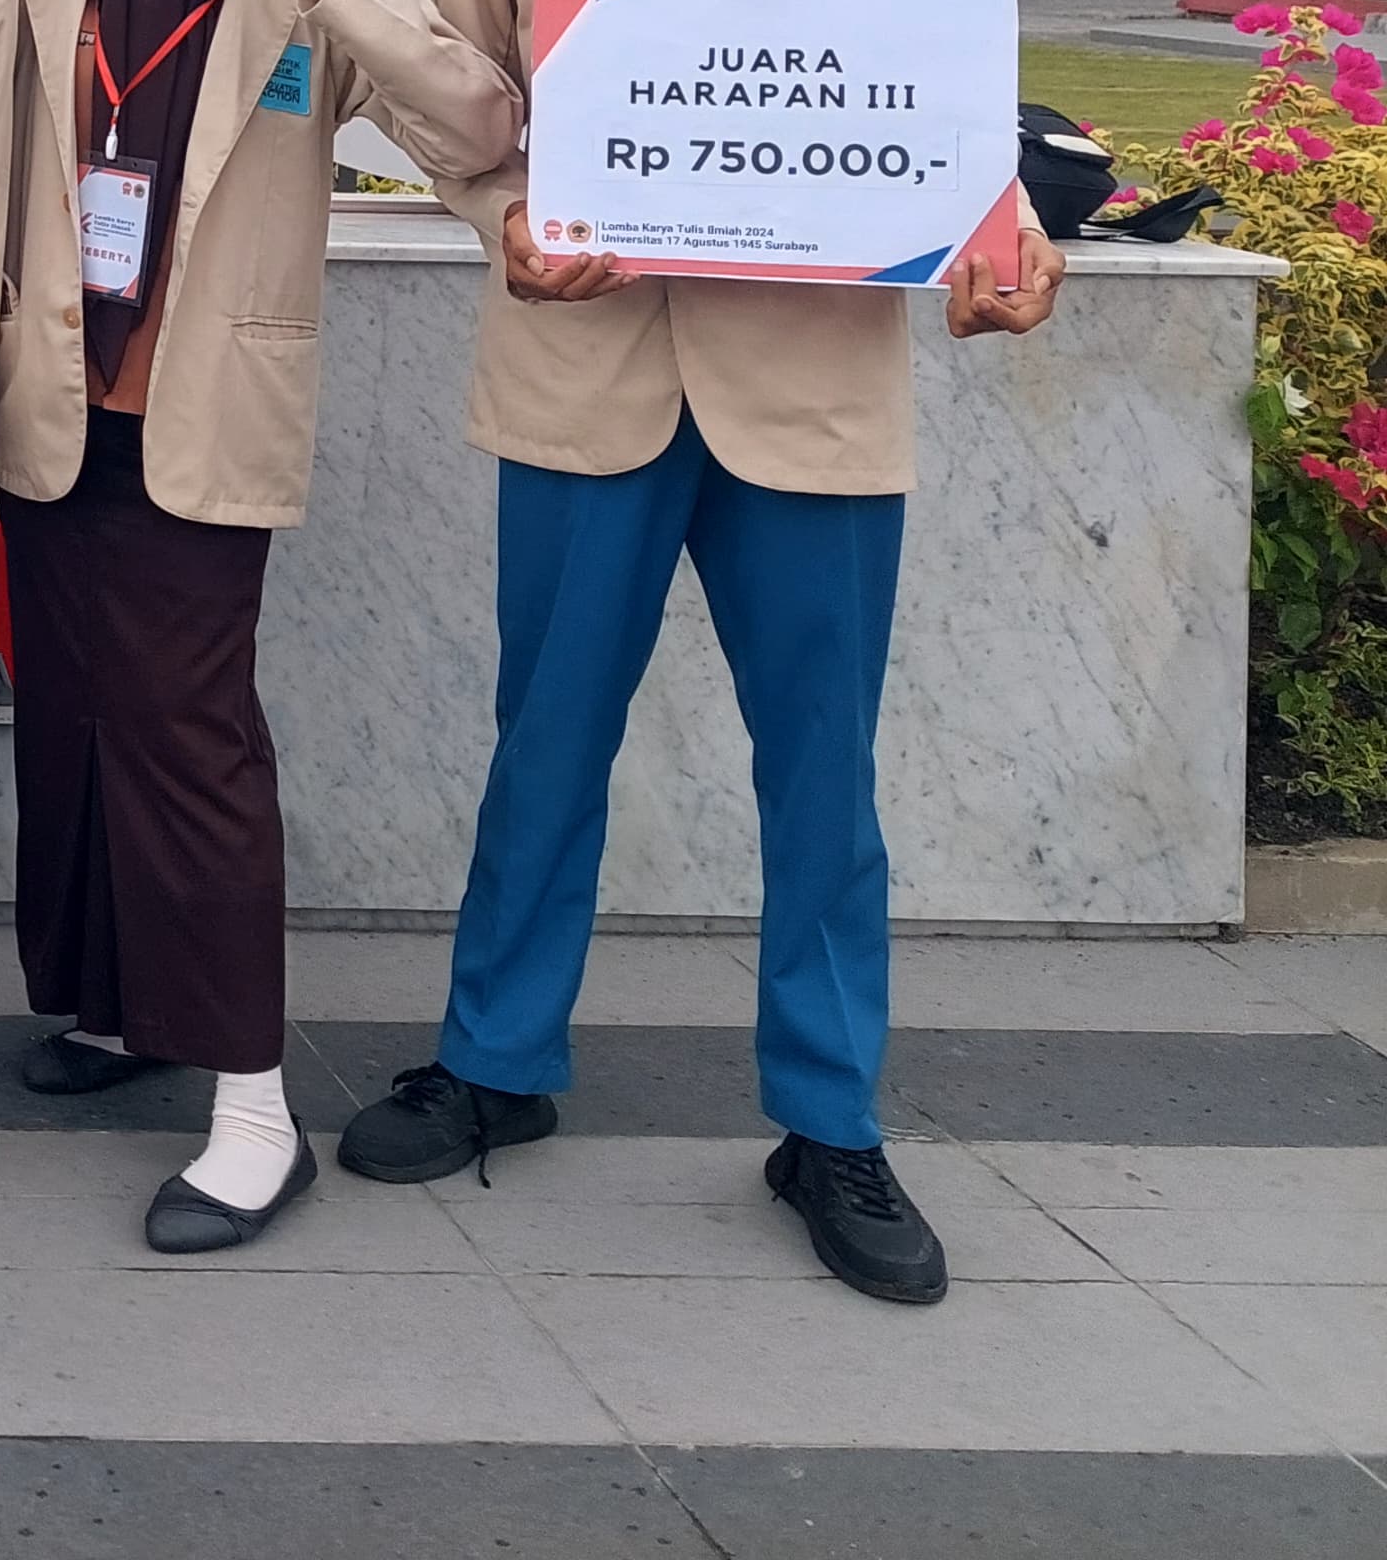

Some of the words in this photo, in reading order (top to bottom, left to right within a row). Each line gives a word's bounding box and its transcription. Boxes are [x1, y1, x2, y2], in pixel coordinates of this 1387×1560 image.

[698, 47, 843, 73] JUARA
[630, 80, 845, 108] HARAPAN
[867, 84, 916, 109] III
[607, 138, 670, 177] Rp
[689, 140, 947, 186] 750.000,-
[601, 221, 640, 232] Lomba
[642, 223, 674, 235] Karya
[676, 223, 705, 235] Tulis
[707, 224, 742, 236] Ilmiah
[744, 226, 775, 237] 2024
[601, 233, 664, 246] Universitas
[666, 235, 681, 245] 17
[683, 236, 730, 250] Agustus
[733, 239, 763, 250] 1945
[764, 240, 819, 253] Surabaya
[82, 246, 132, 265] ESERTA
